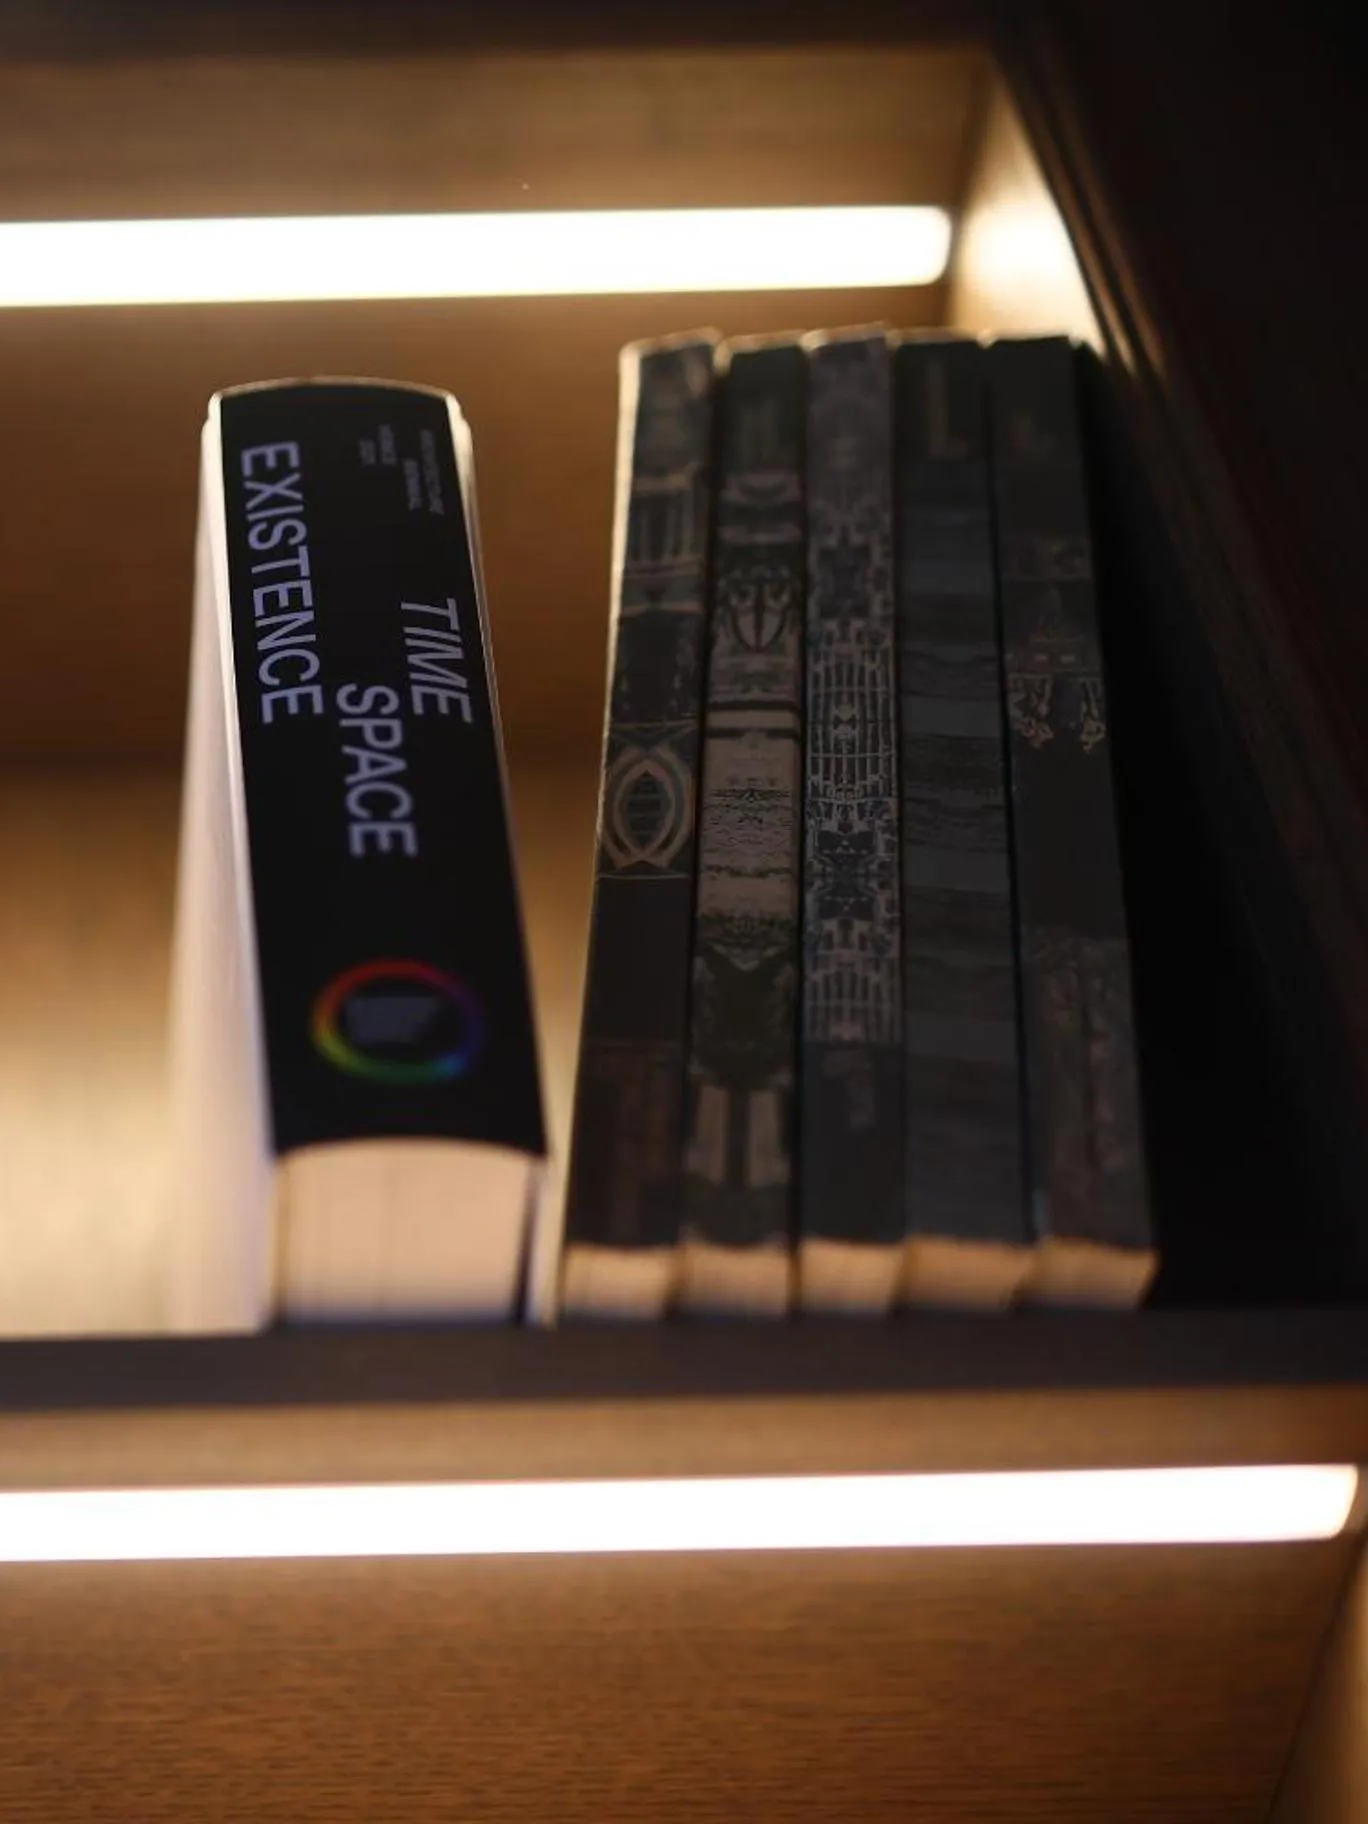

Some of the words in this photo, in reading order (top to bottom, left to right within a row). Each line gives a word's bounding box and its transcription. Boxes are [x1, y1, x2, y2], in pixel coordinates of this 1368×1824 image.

[241, 440, 324, 725] EXISTENCE
[400, 598, 473, 724] TIME
[335, 682, 419, 859] SPACE
